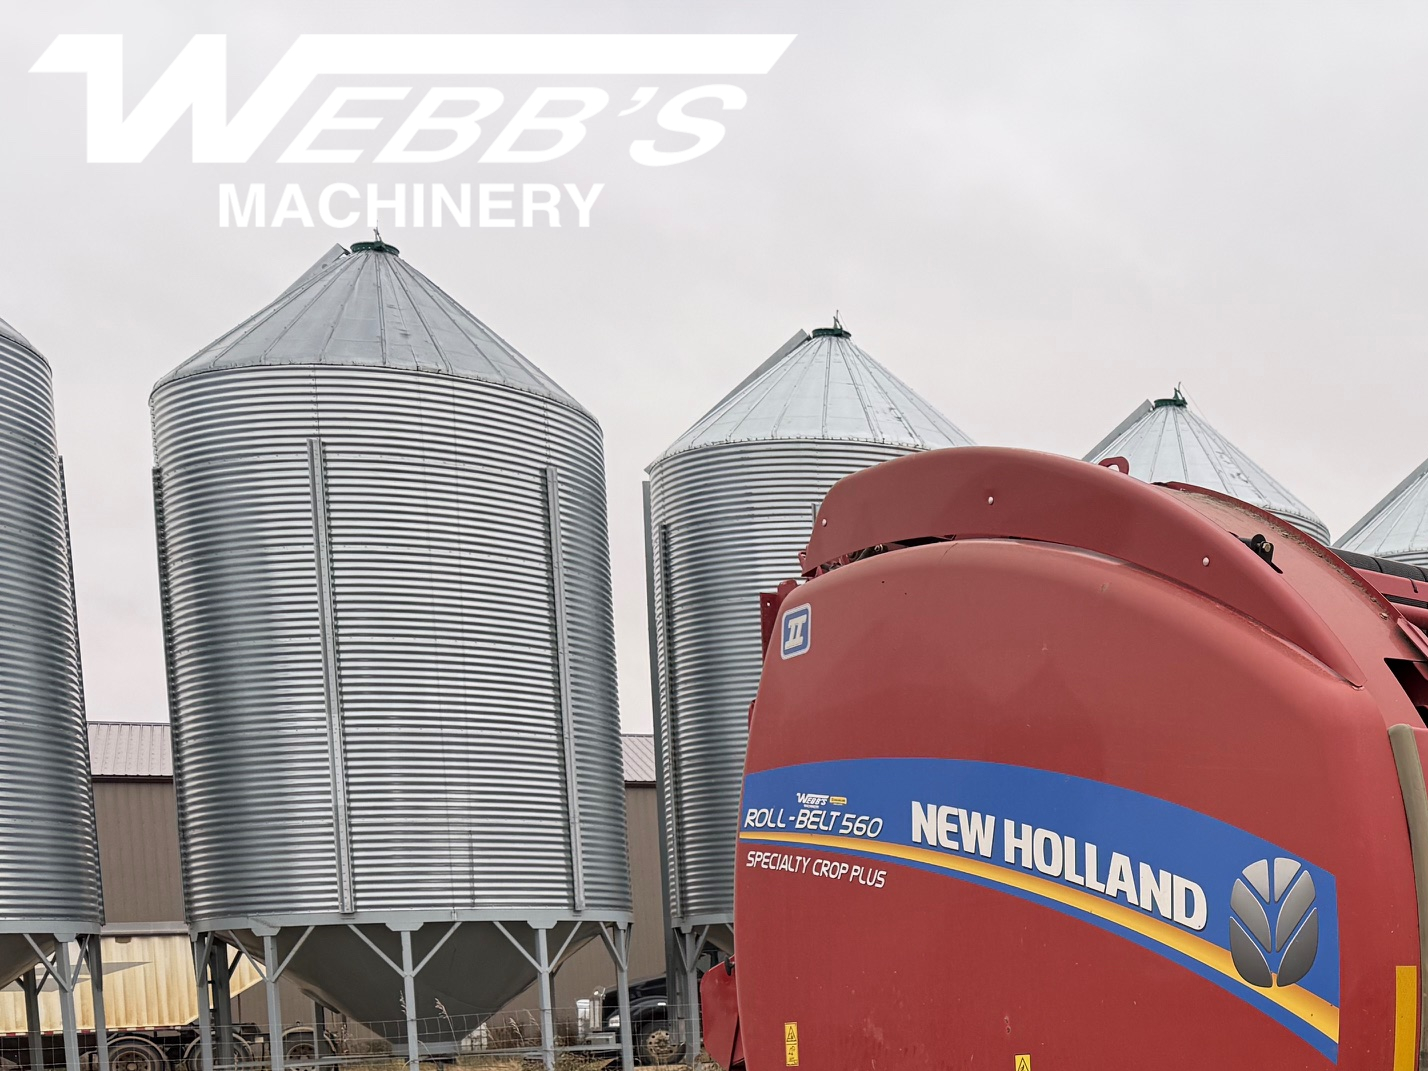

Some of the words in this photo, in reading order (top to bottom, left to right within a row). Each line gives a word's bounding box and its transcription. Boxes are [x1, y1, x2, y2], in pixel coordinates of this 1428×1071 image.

[796, 792, 829, 806] WEBB'S
[839, 813, 883, 838] 560
[746, 851, 811, 874] SPECIALTY
[812, 859, 849, 880] CROP
[849, 865, 887, 888] PLUS
[911, 800, 996, 858] NEW
[1004, 818, 1208, 931] HOLLAND
